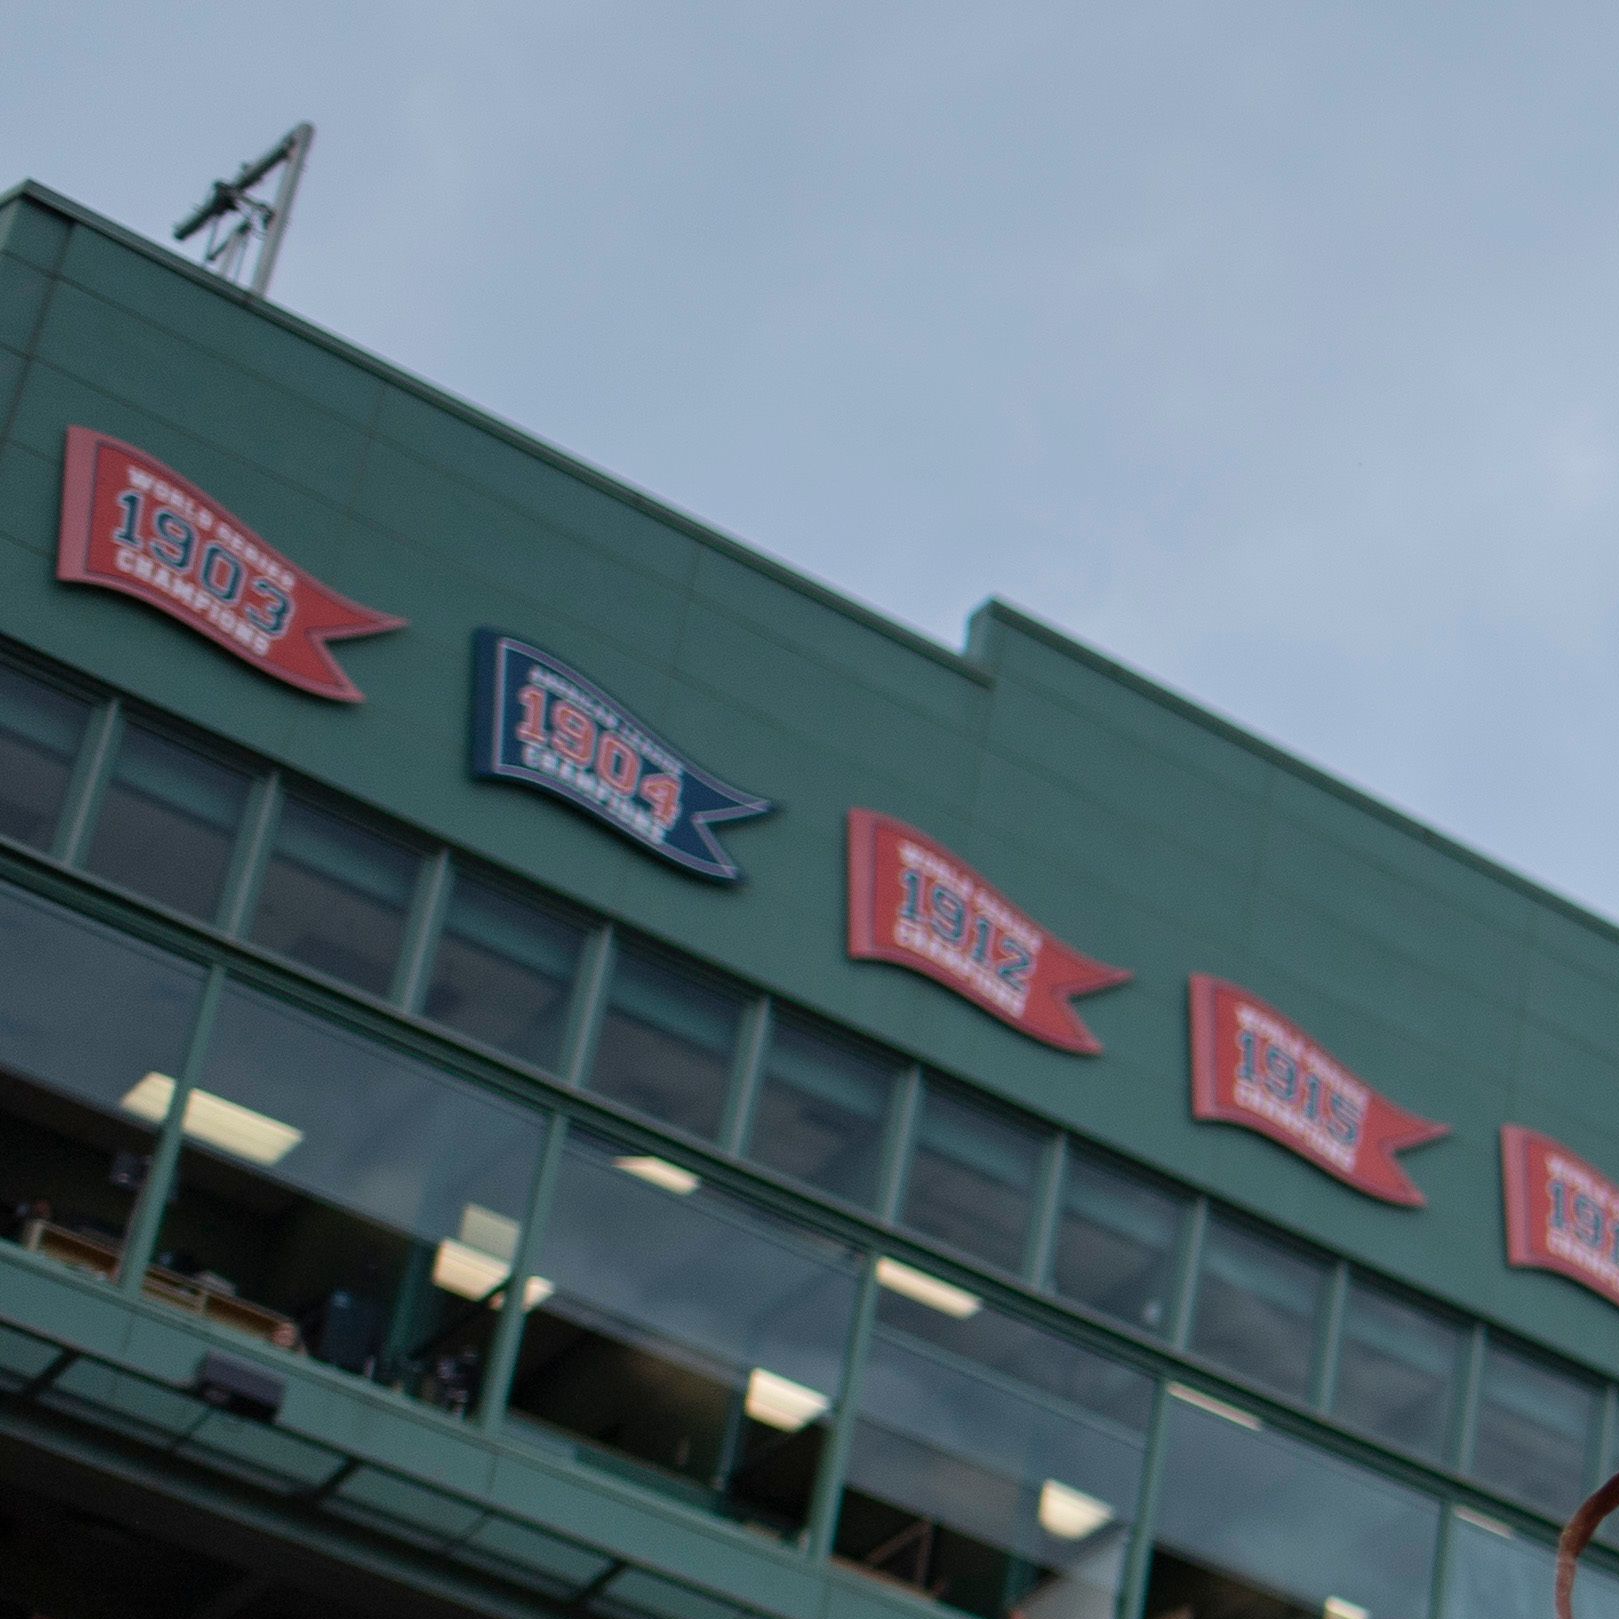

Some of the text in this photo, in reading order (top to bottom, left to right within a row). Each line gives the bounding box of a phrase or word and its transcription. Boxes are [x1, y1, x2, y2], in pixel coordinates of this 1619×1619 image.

[112, 489, 296, 640] 1903
[115, 547, 270, 656] CHAMPIONS
[516, 684, 682, 829] 1904
[899, 868, 1036, 993] 1912
